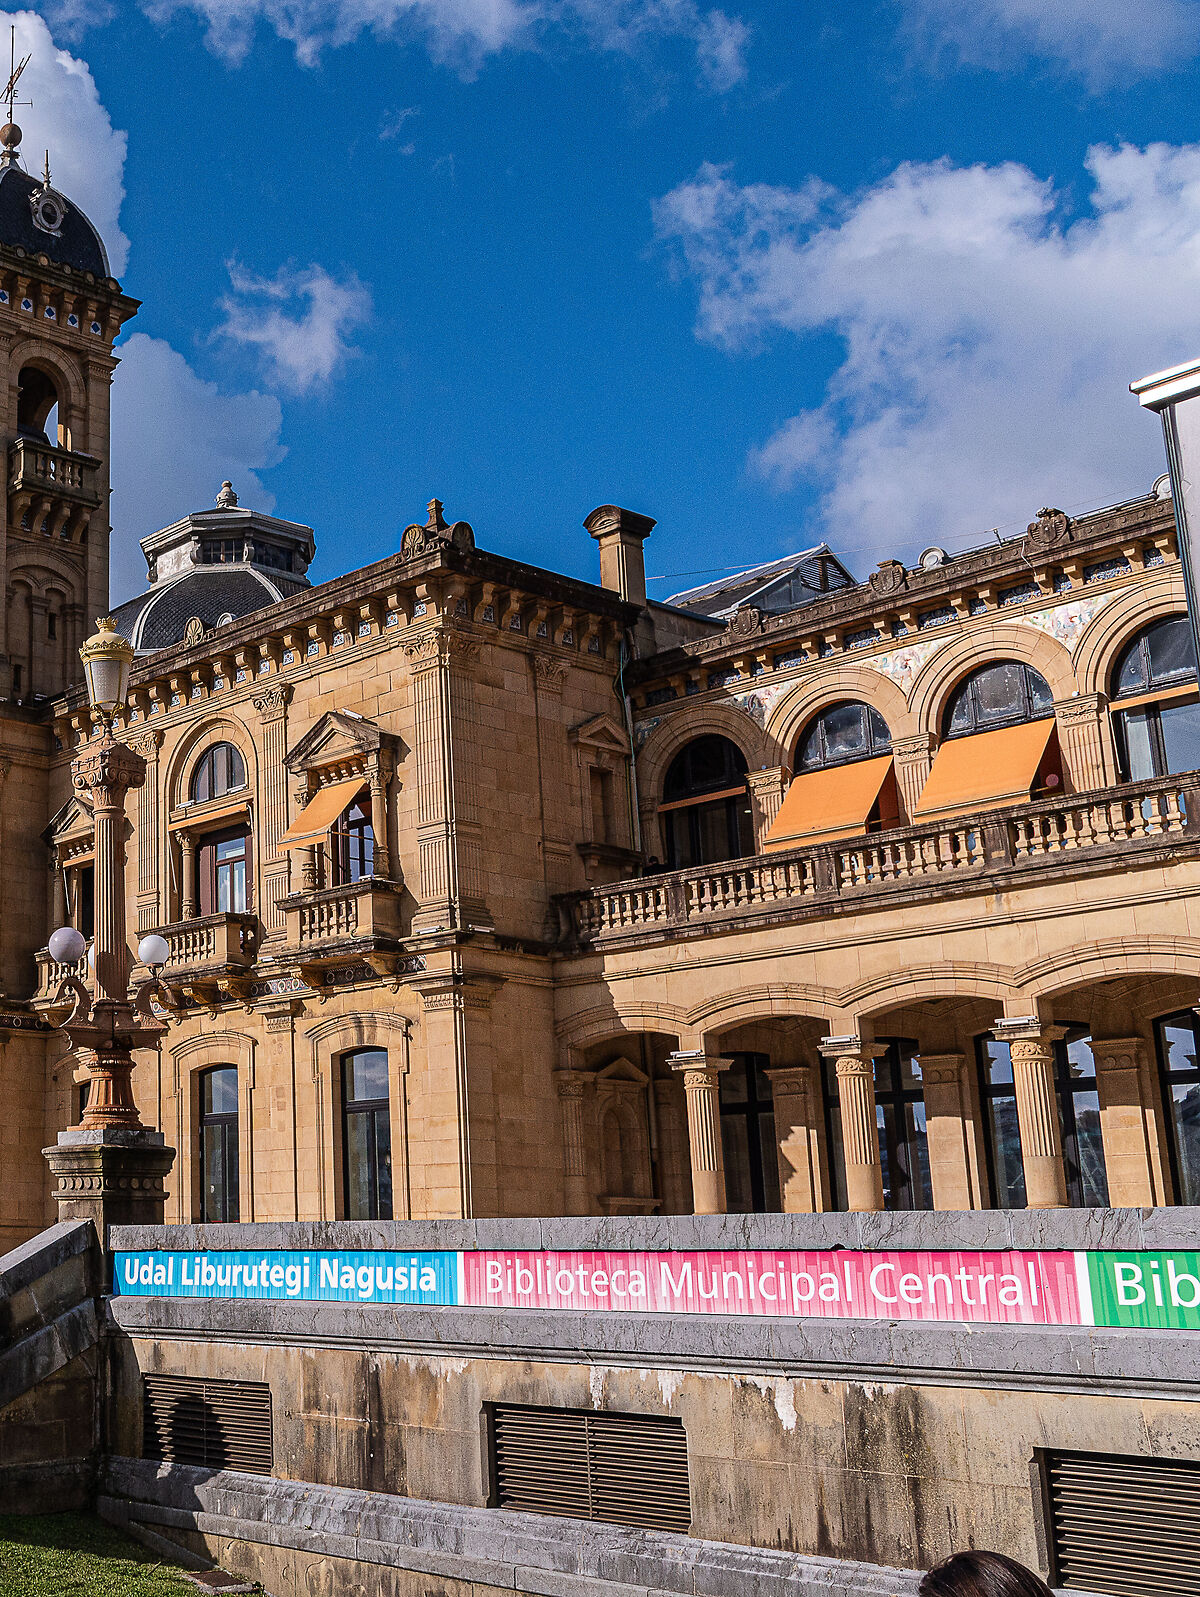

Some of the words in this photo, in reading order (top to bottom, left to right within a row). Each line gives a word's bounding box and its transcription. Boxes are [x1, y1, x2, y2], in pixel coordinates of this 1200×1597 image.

[124, 1258, 173, 1286] Udal
[181, 1256, 310, 1296] Liburutegi
[318, 1258, 436, 1298] Nagusia
[487, 1259, 647, 1298] Biblioteca
[659, 1260, 853, 1312] Municipal
[869, 1261, 1039, 1306] Central
